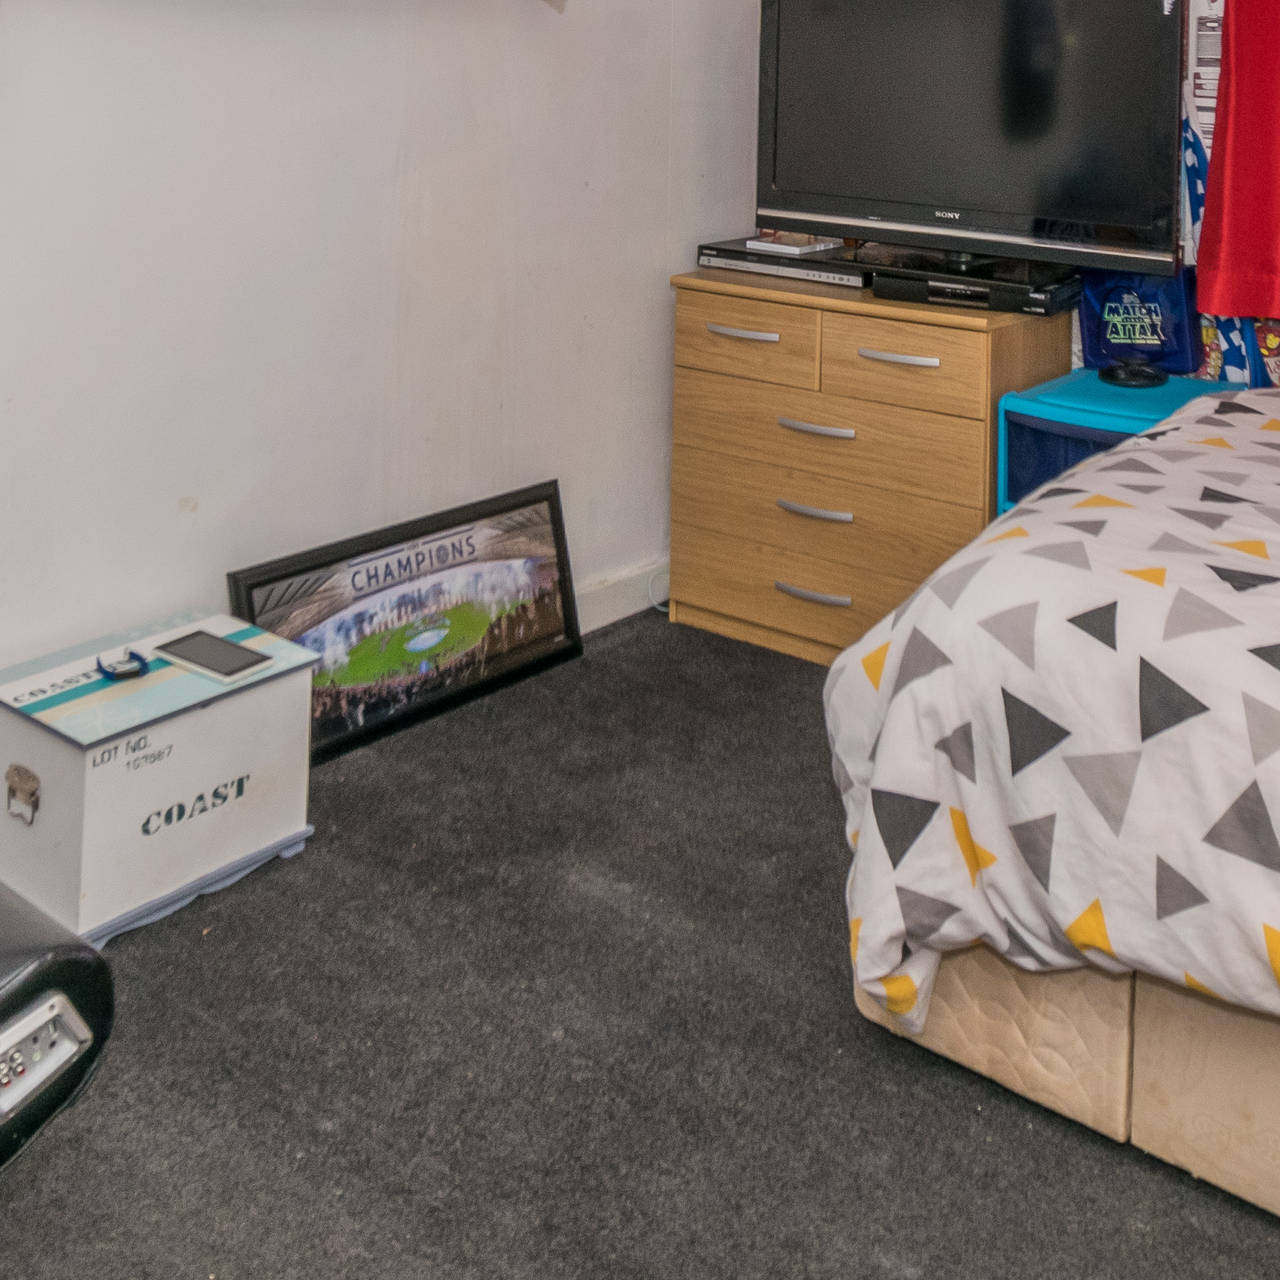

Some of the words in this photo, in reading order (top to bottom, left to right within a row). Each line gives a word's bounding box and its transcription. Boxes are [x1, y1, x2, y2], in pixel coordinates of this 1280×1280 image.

[935, 211, 960, 220] SONY
[1104, 303, 1161, 320] MATCH
[1107, 321, 1164, 339] ATTAX
[351, 535, 476, 592] CHAMPIONS
[92, 745, 119, 768] LOT
[141, 774, 250, 836] COAST
